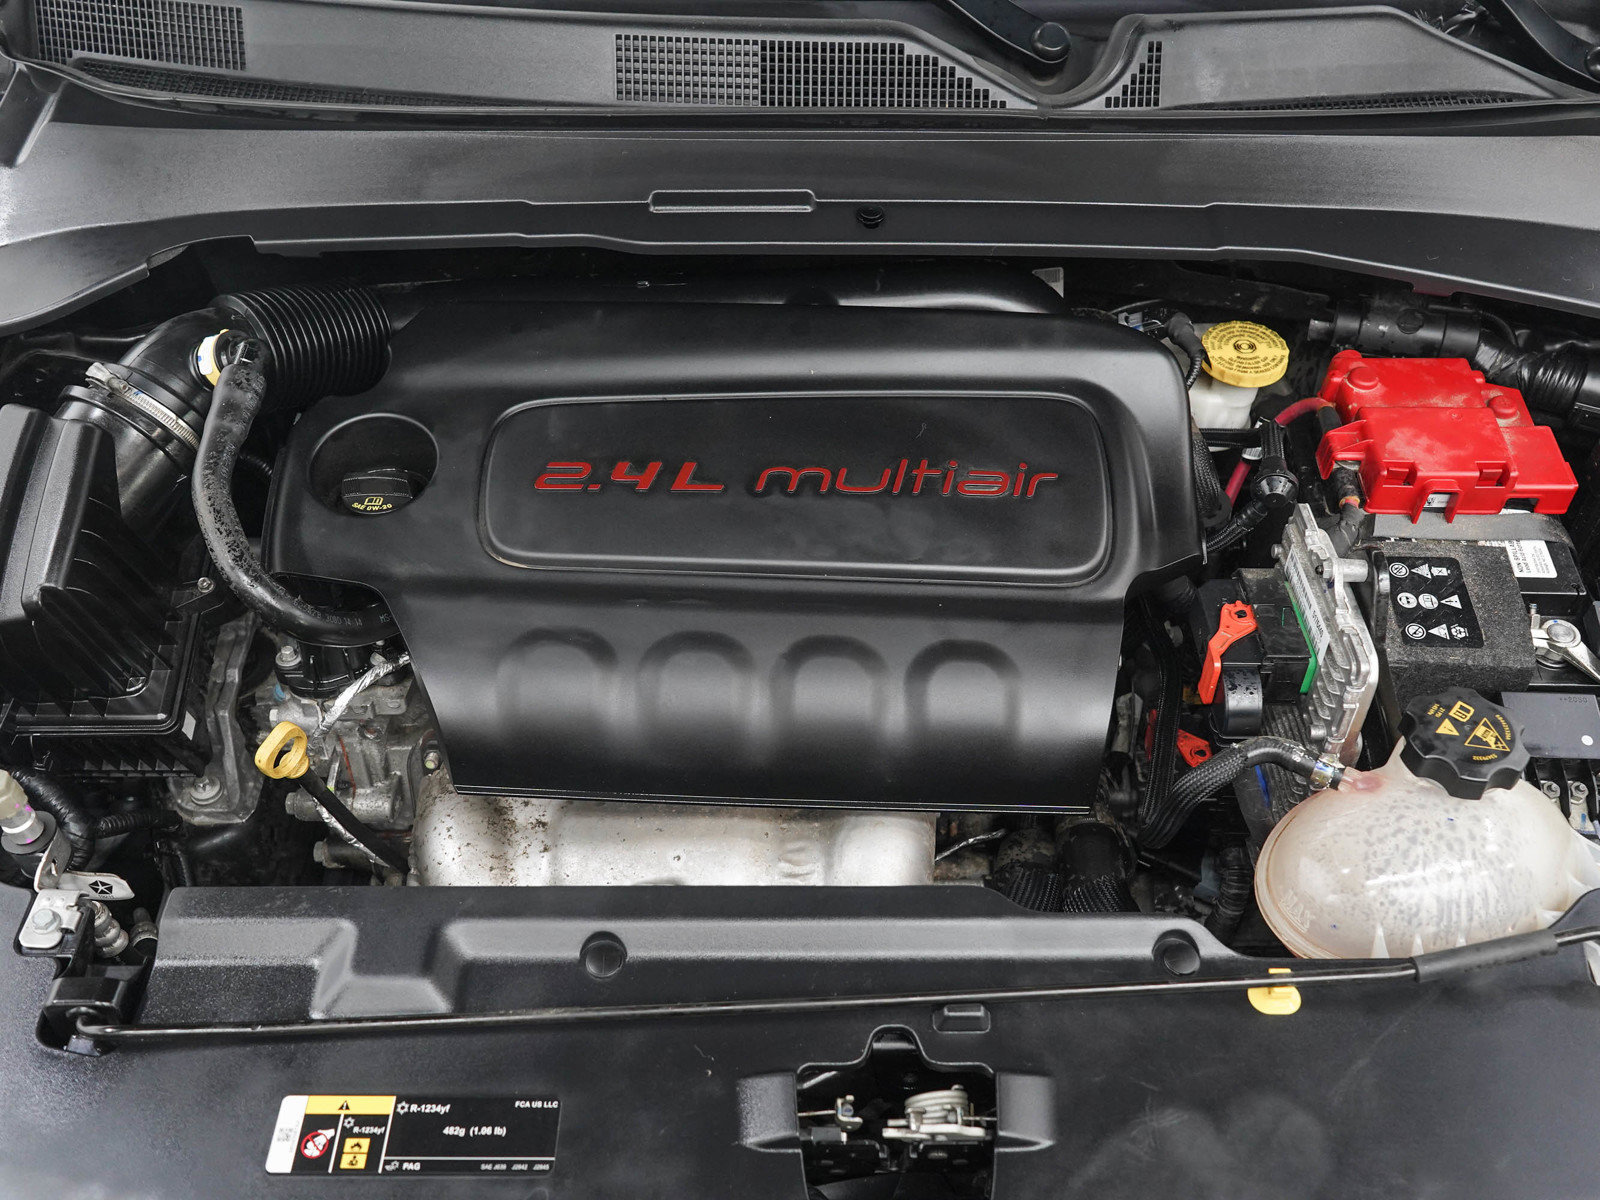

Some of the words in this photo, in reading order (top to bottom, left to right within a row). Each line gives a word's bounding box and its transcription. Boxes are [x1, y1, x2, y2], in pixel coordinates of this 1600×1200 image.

[534, 461, 725, 493] 2.4L
[755, 458, 1059, 499] multiair
[409, 1103, 451, 1115] R-1234yf
[515, 1100, 530, 1108] FCA
[531, 1100, 542, 1108] US
[543, 1100, 559, 1109] LLC
[442, 1126, 466, 1138] 482g
[402, 1161, 421, 1171] PAG
